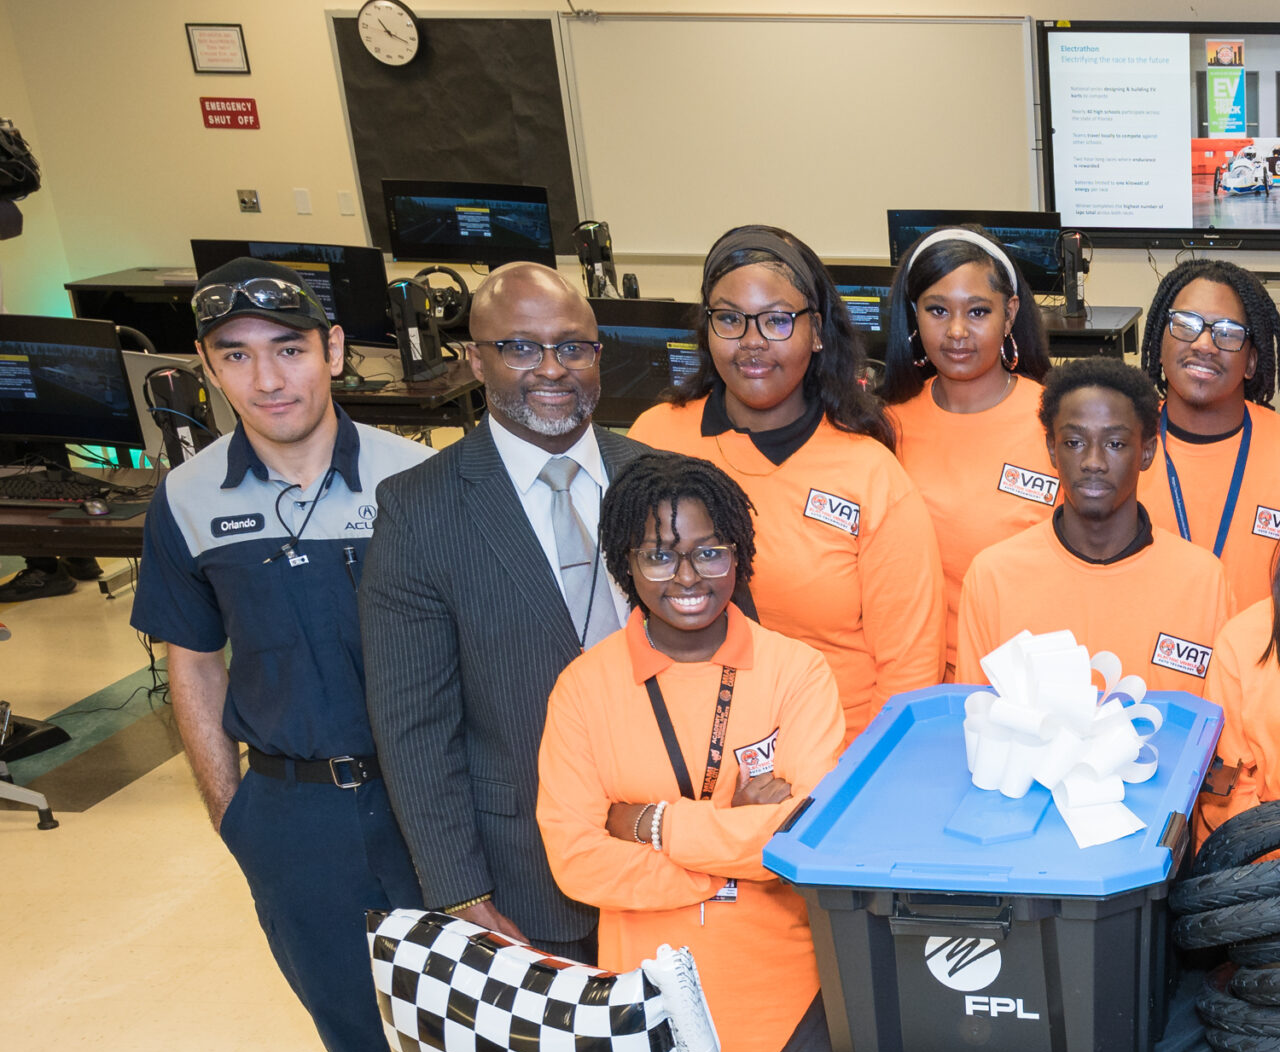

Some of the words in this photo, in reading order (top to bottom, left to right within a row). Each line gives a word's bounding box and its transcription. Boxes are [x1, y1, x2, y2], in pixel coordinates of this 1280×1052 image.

[1213, 78, 1239, 97] EV
[205, 101, 252, 112] EMERGENCY
[208, 115, 231, 124] SHUT
[237, 116, 254, 125] OFF
[1021, 473, 1056, 494] VAT
[829, 498, 860, 523] VAT
[221, 518, 256, 531] Orlando
[1176, 643, 1209, 665] VAT
[965, 995, 1040, 1020] FPL
